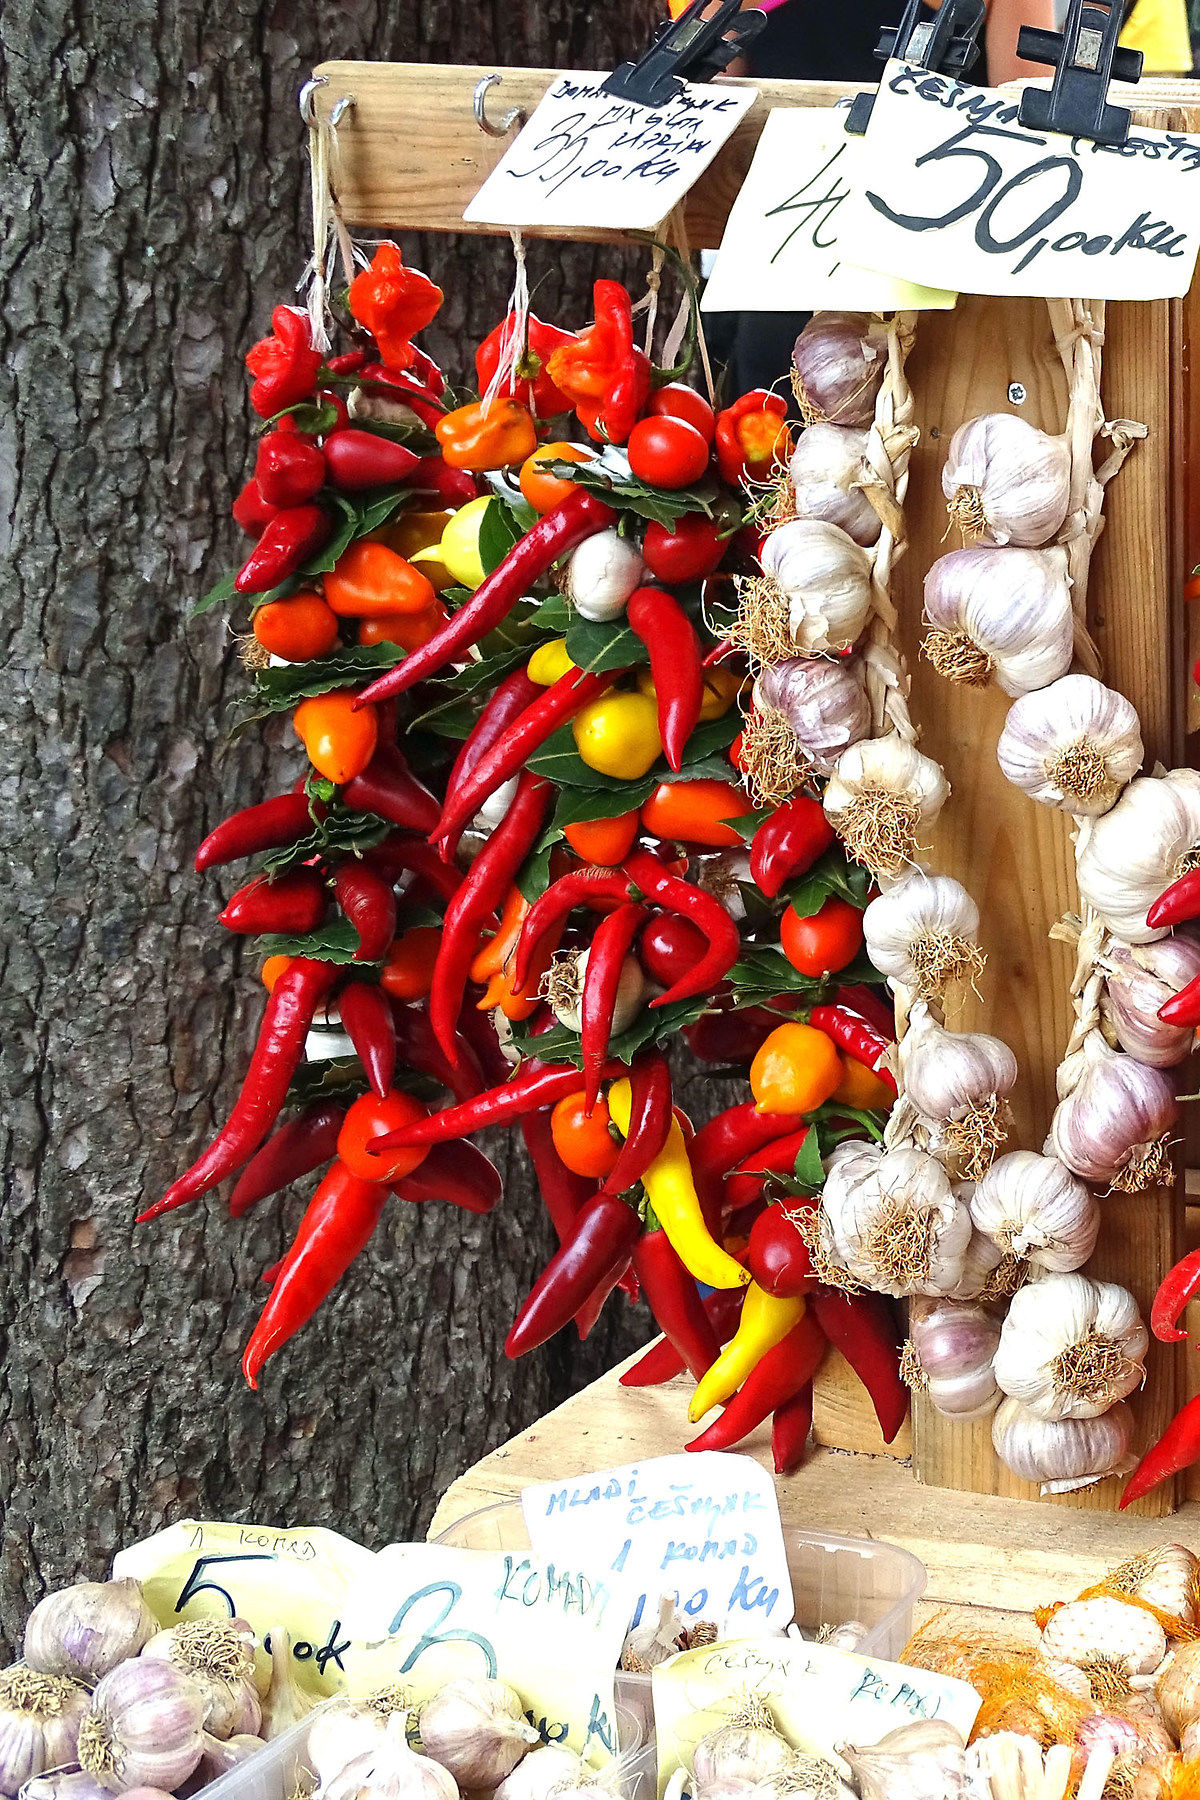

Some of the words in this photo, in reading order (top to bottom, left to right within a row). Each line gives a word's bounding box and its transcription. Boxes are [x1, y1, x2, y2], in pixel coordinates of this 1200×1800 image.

[888, 65, 1020, 124] ČEŠNJA
[598, 105, 645, 125] MIX
[611, 1538, 632, 1572] 1
[660, 1532, 758, 1570] KOMAD
